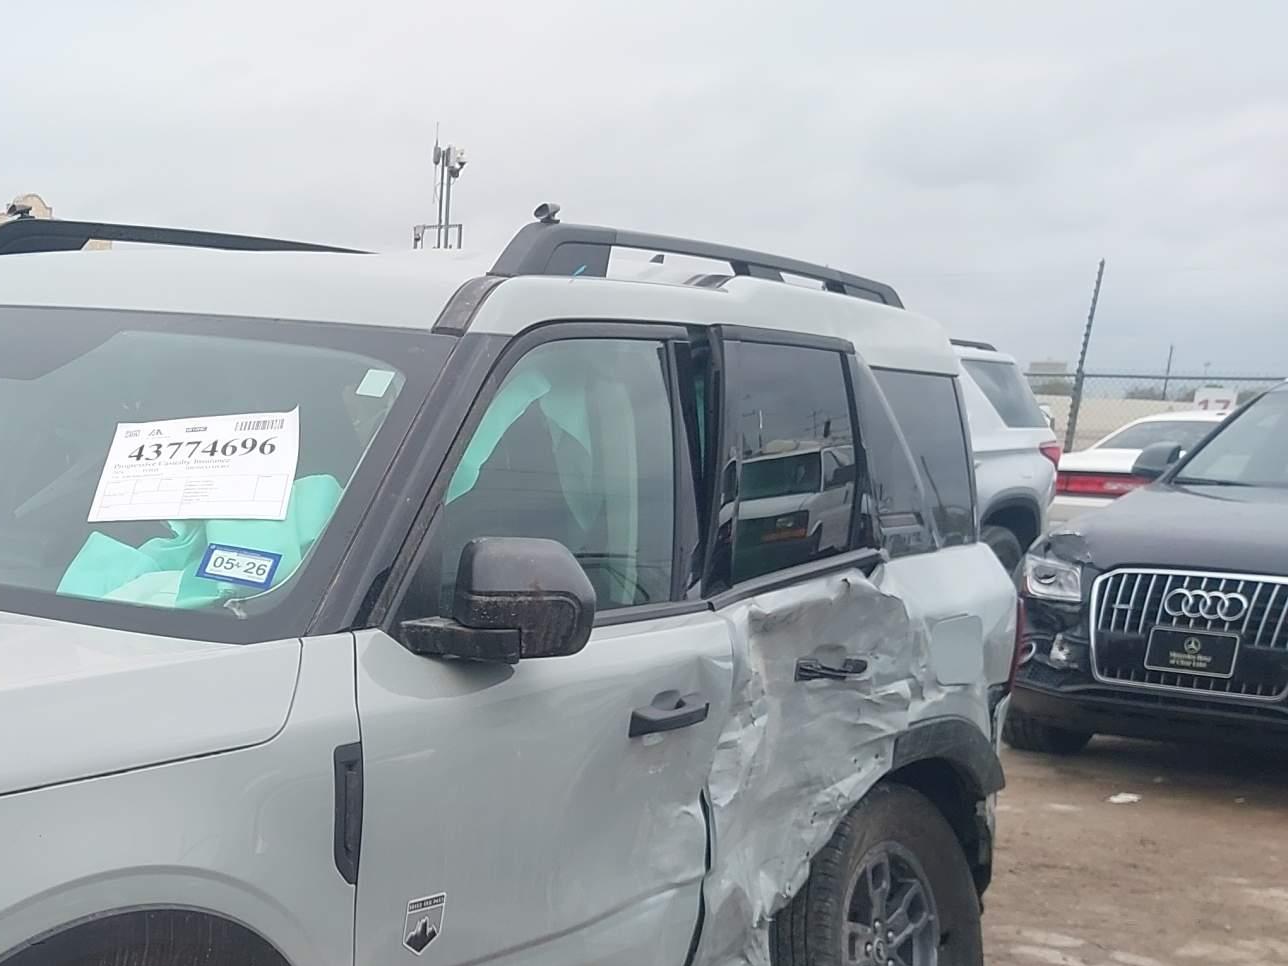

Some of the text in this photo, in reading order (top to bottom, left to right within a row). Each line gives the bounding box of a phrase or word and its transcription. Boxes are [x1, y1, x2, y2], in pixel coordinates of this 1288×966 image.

[127, 435, 279, 462] 43774696
[213, 556, 268, 576] 05 26
